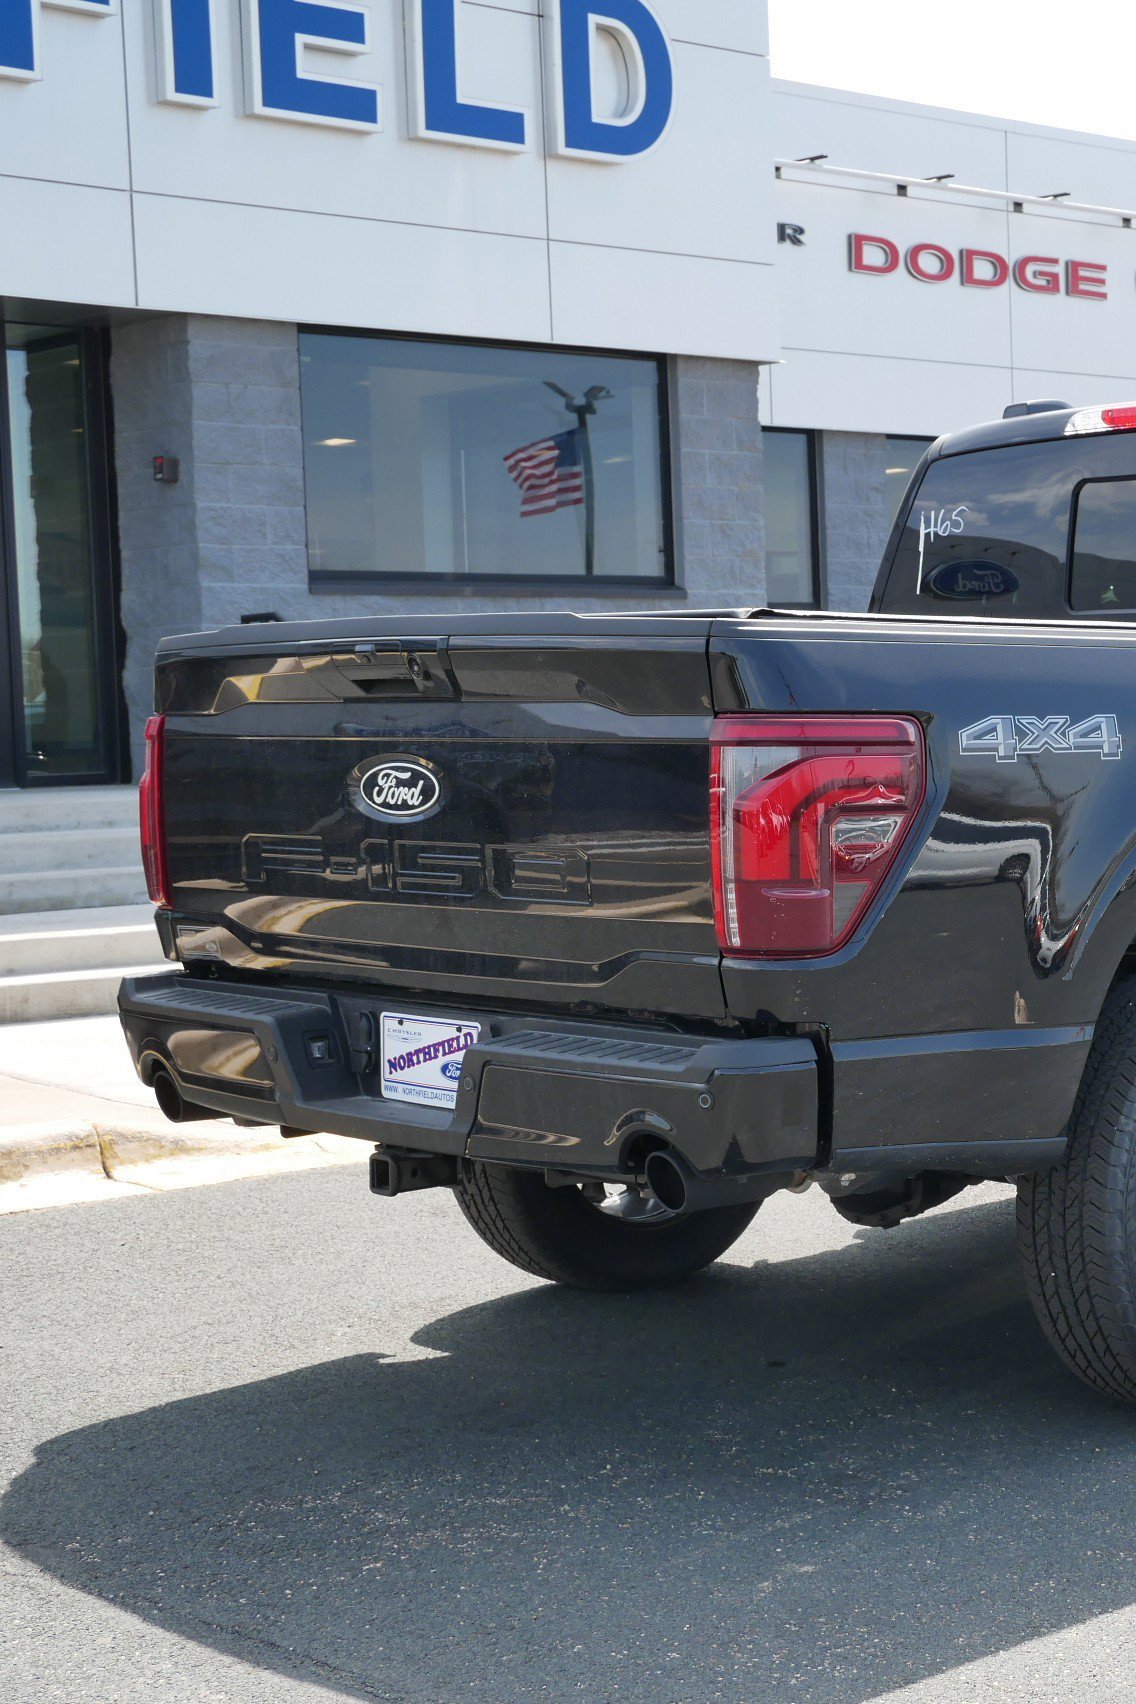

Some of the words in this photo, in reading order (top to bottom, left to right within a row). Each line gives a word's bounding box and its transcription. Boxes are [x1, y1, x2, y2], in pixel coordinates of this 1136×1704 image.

[848, 233, 1108, 301] DODGE
[372, 769, 424, 807] Ford
[240, 832, 593, 906] F-150
[387, 1028, 423, 1037] CHRYSLER
[387, 1031, 475, 1075] NORTHFIELD
[402, 1086, 455, 1103] NORTHFIELDAUTOS
